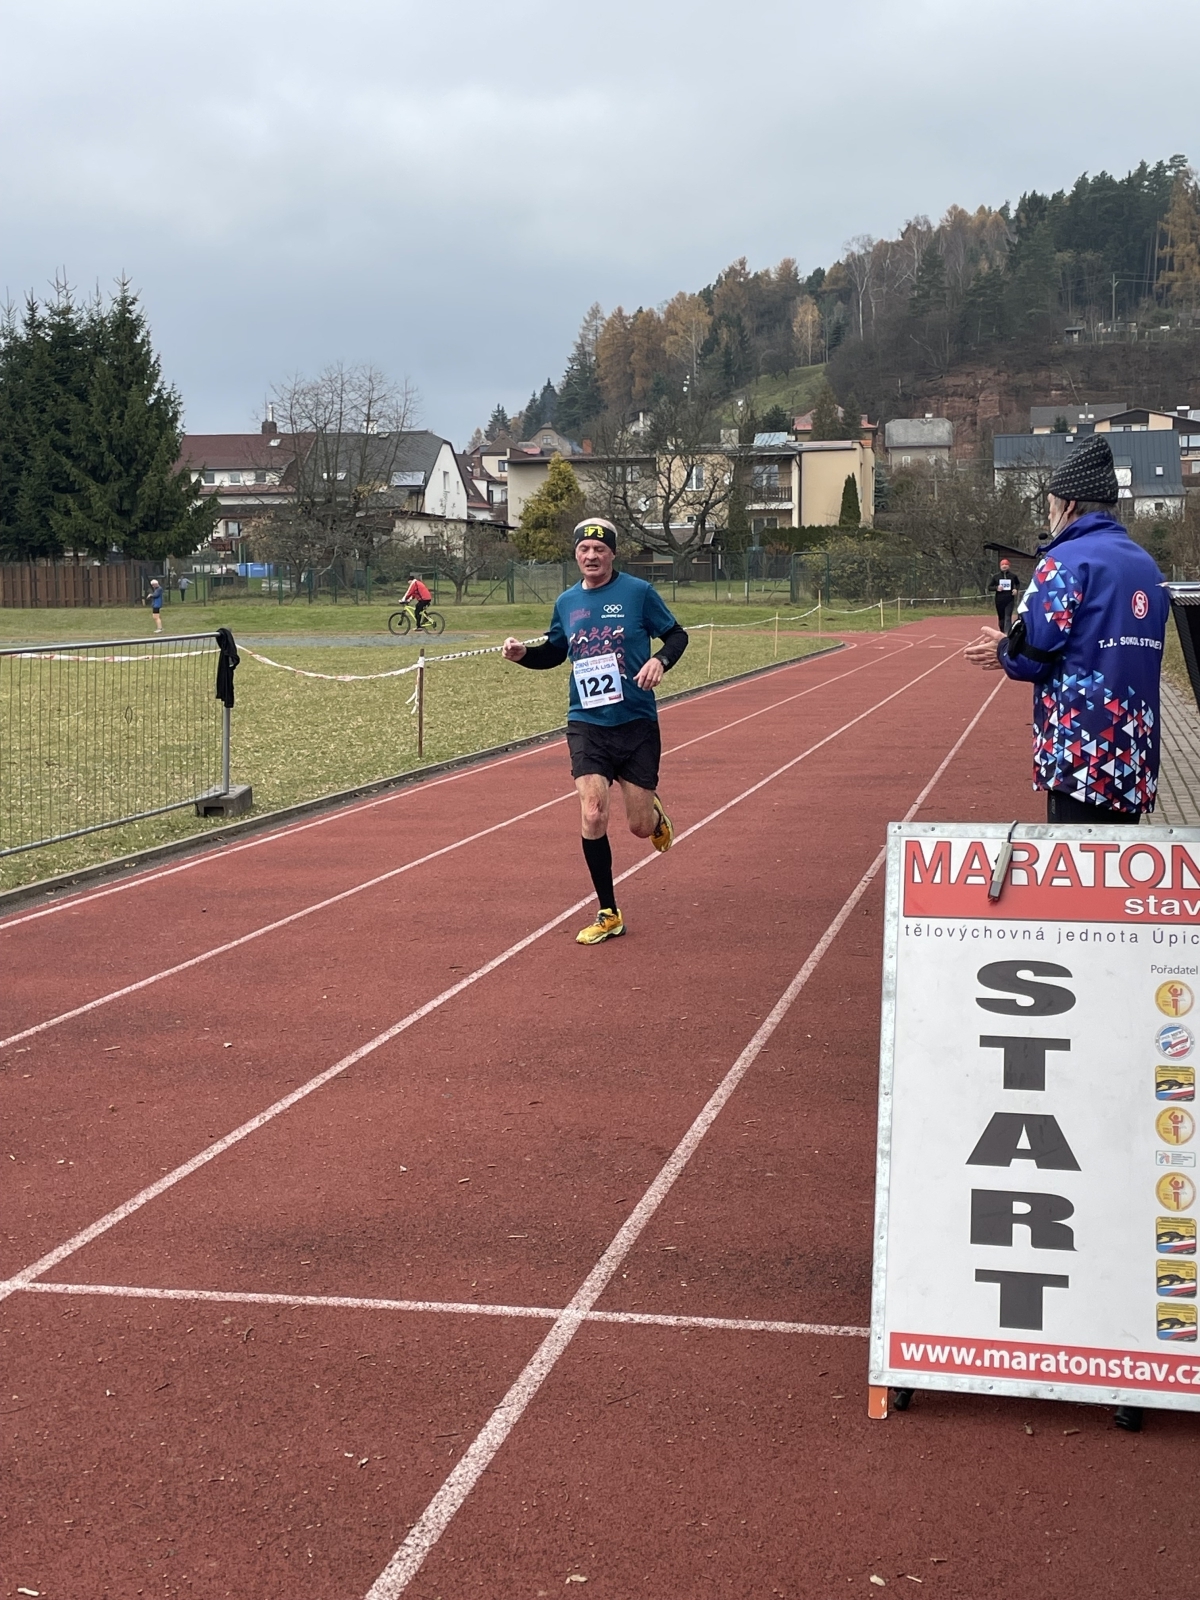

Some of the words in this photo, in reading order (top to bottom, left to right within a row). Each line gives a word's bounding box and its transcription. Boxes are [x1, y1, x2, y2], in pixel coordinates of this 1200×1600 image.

[1098, 638, 1118, 649] T.J.
[579, 674, 616, 698] 122
[905, 839, 1200, 890] MARATON
[1124, 894, 1200, 916] stav
[904, 923, 1046, 942] tělovýchovná
[1057, 927, 1139, 945] jednota
[1152, 927, 1200, 948] Úpic
[1150, 963, 1199, 976] Pořadatel
[965, 959, 1081, 1331] START
[899, 1341, 1200, 1386] www.maratonstav.cz
